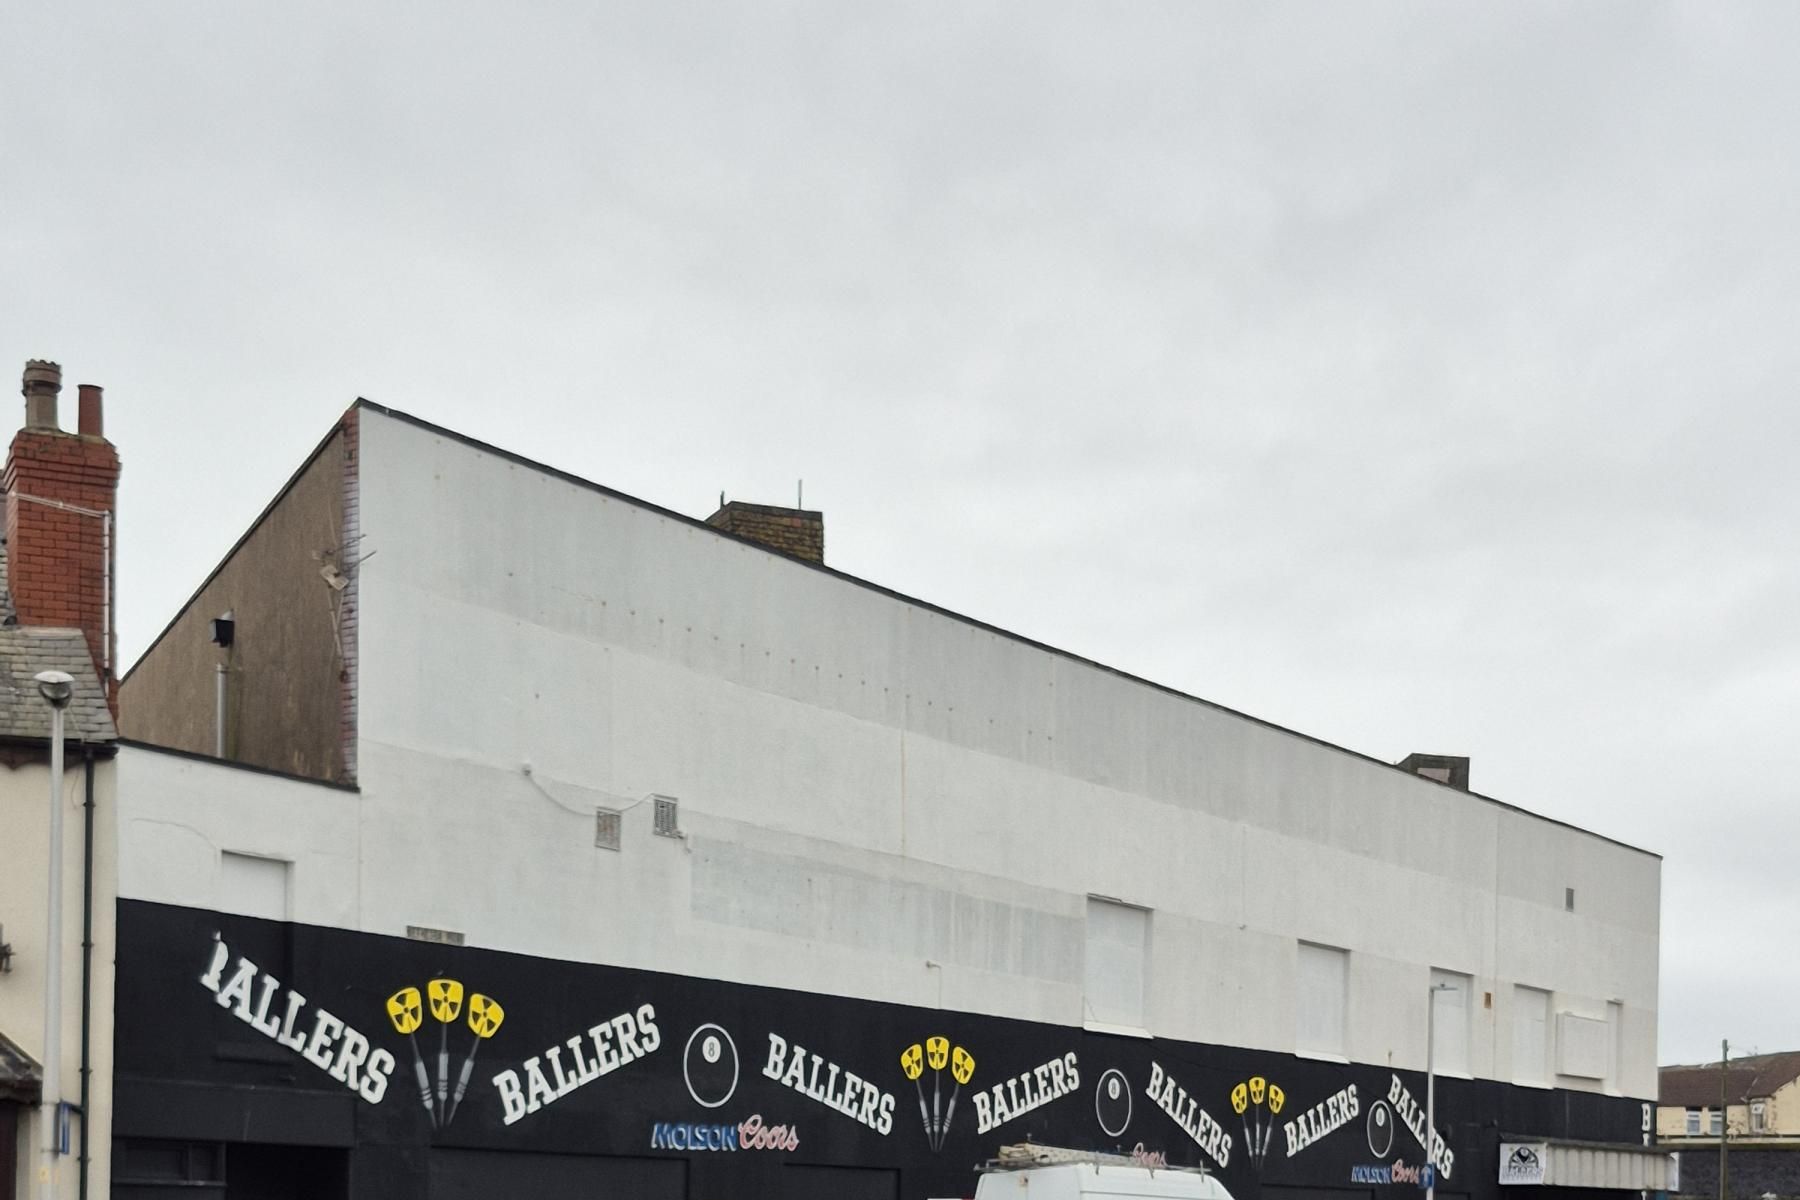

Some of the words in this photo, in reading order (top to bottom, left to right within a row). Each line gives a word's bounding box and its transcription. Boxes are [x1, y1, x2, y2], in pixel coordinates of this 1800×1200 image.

[492, 1003, 661, 1126] BALLERS
[762, 1032, 896, 1136] BALLERS
[972, 1051, 1080, 1135] BALLERS
[651, 1123, 737, 1151] MOLSON
[737, 1114, 799, 1151] Coors
[1145, 1060, 1232, 1168] BALLERS
[1283, 1083, 1359, 1158] BALLERS
